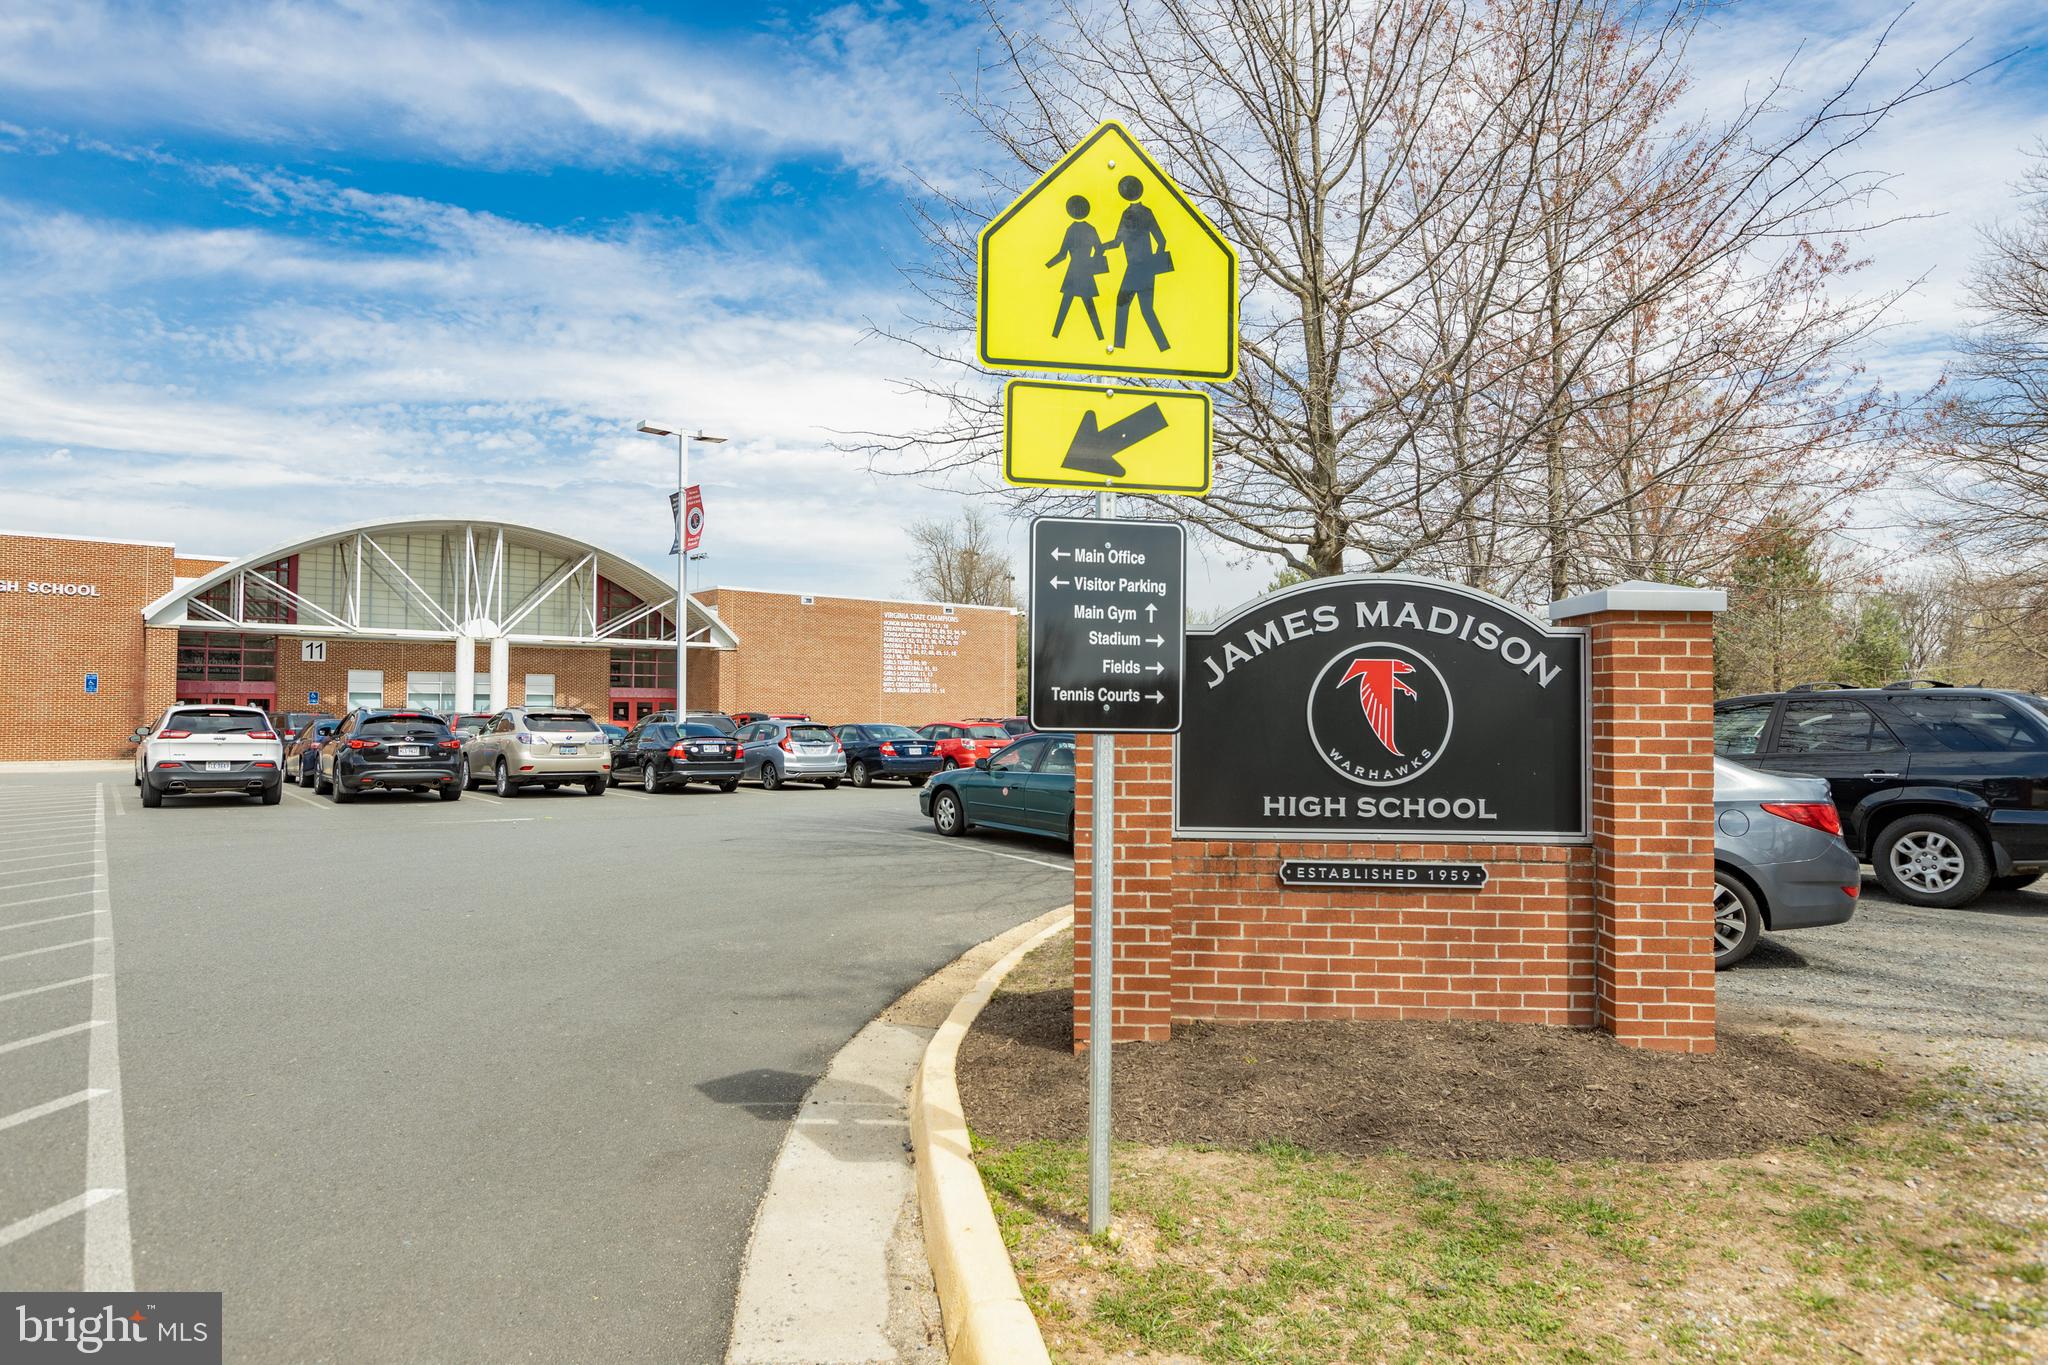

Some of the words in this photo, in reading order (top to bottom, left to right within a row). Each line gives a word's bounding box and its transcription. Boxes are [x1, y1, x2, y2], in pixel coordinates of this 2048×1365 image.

[1074, 548, 1105, 563] Main
[1108, 549, 1146, 565] Office
[27, 581, 100, 596] SCHOOL
[1074, 576, 1116, 592] Visitor
[1119, 578, 1166, 596] Parking
[1074, 604, 1104, 619] Main
[1107, 606, 1137, 623] Gym
[1088, 630, 1141, 646] Stadium
[1203, 605, 1340, 690] JAMES
[1355, 600, 1562, 689] MADISON
[305, 642, 323, 659] 11
[193, 656, 241, 665] Wrhawks
[1102, 659, 1141, 674] Fields
[1051, 686, 1095, 701] Tennis
[1097, 687, 1141, 702] Courts
[1329, 748, 1432, 779] WARHAWKS
[1263, 796, 1347, 817] HIGH
[1356, 797, 1497, 819] SCHOOL
[1296, 867, 1418, 881] ESTABLISHED
[1428, 869, 1470, 881] 1959
